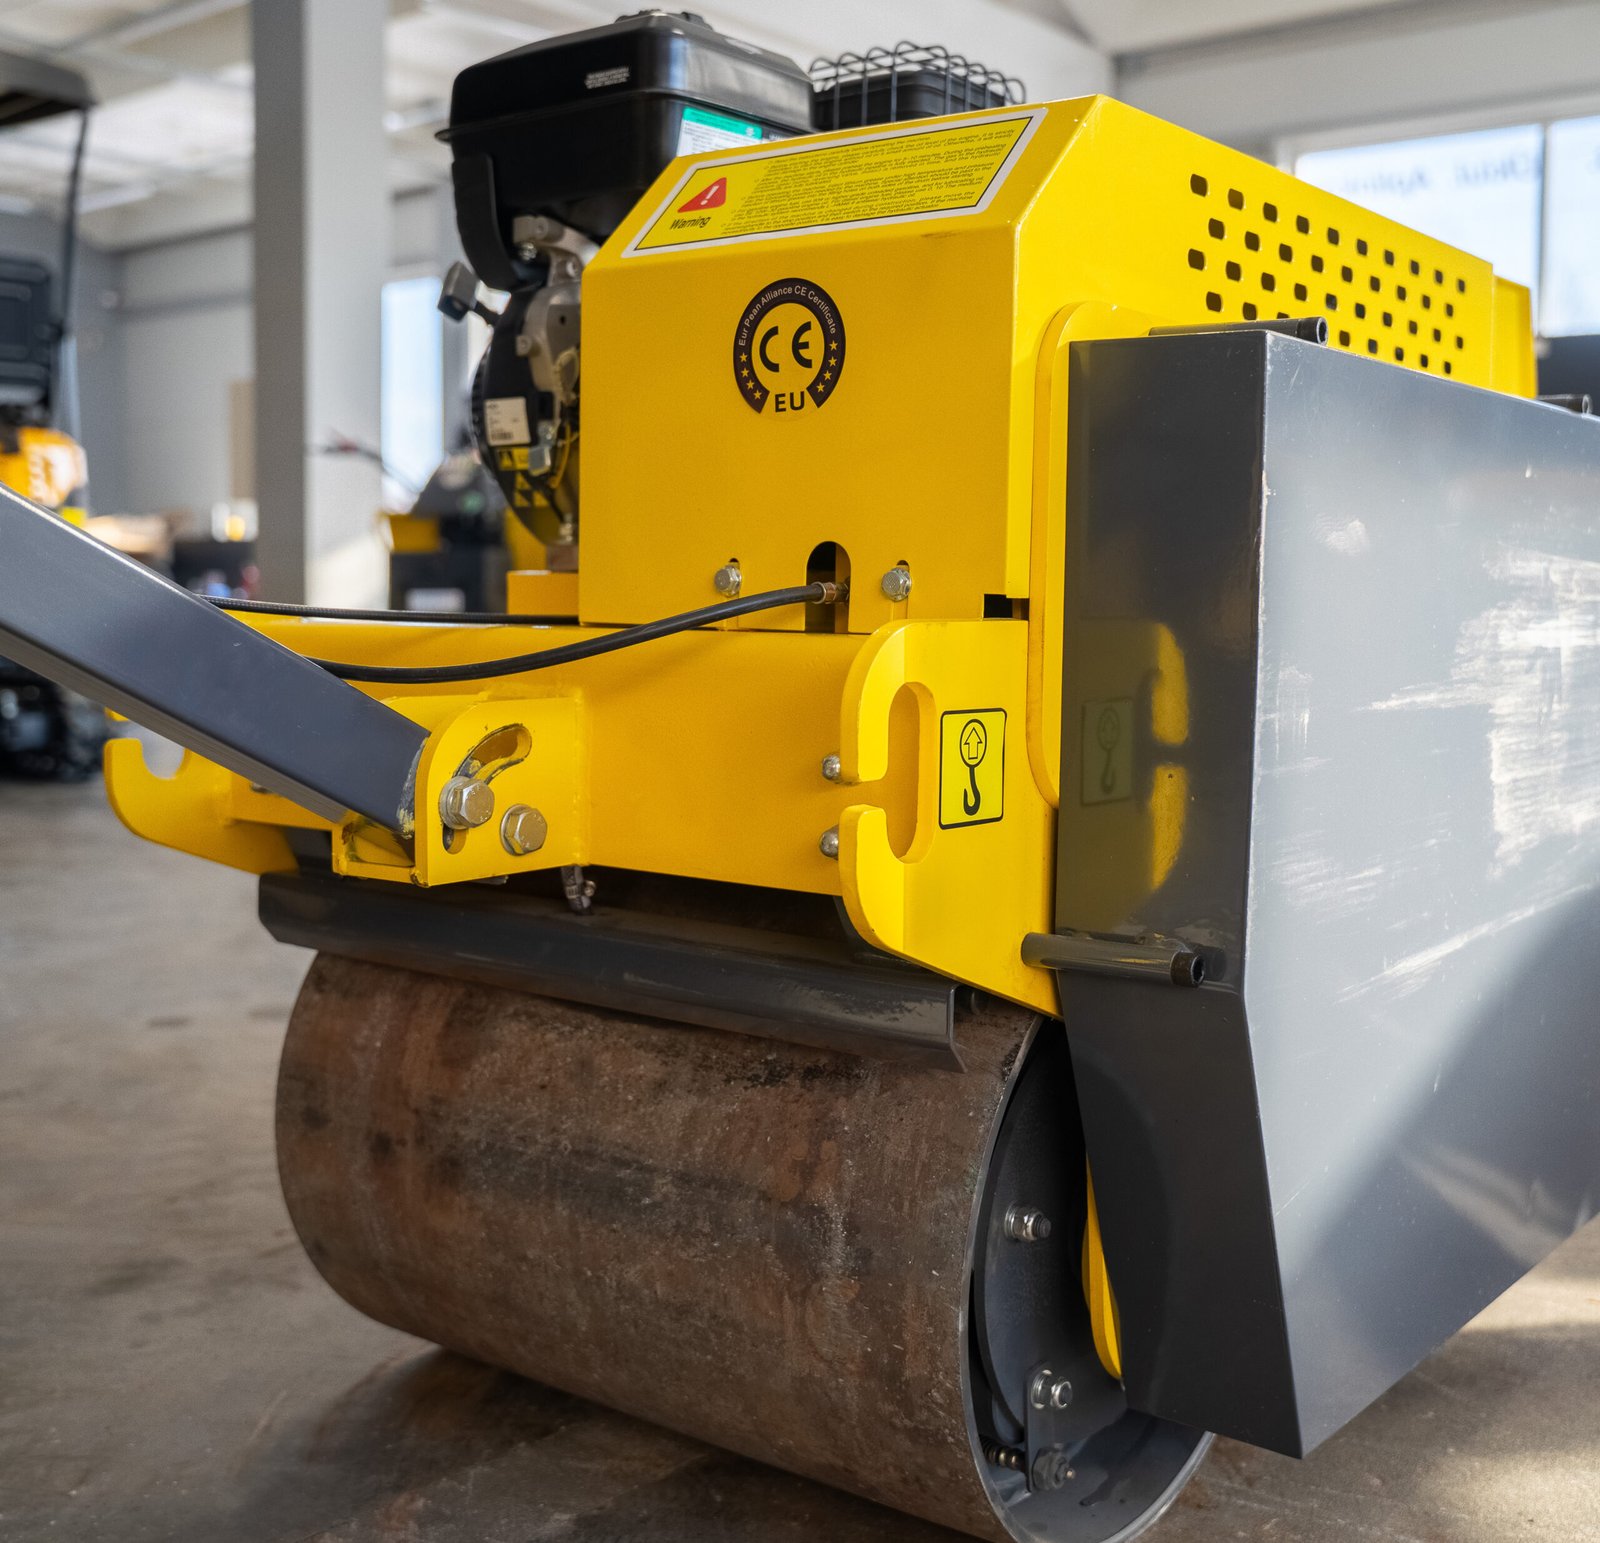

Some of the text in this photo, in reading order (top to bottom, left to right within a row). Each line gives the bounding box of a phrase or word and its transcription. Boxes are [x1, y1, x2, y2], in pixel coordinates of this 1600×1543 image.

[670, 216, 711, 229] Warning
[738, 285, 837, 346] Eur Pean Alliance CE Certificate
[759, 321, 812, 372] CE
[775, 391, 805, 413] EU
